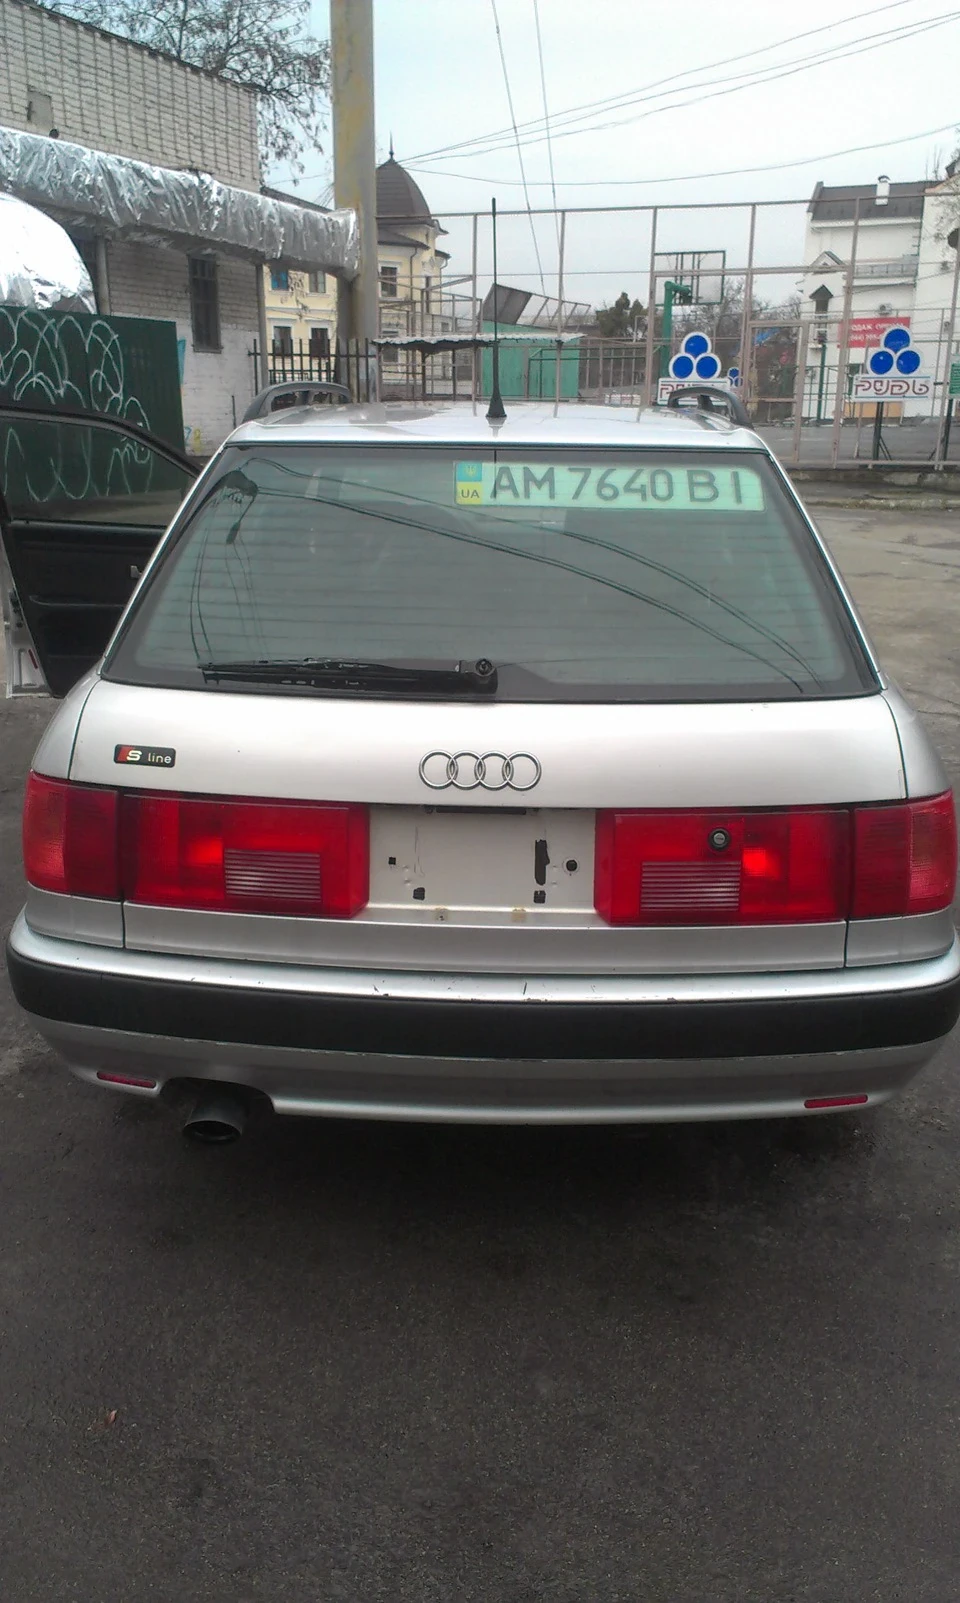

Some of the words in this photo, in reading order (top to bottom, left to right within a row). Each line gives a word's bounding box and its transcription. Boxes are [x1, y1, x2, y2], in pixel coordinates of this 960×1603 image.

[490, 466, 555, 500] AM
[567, 467, 674, 501] 7640
[460, 489, 480, 499] UA
[126, 749, 142, 762] S
[147, 752, 172, 764] line
